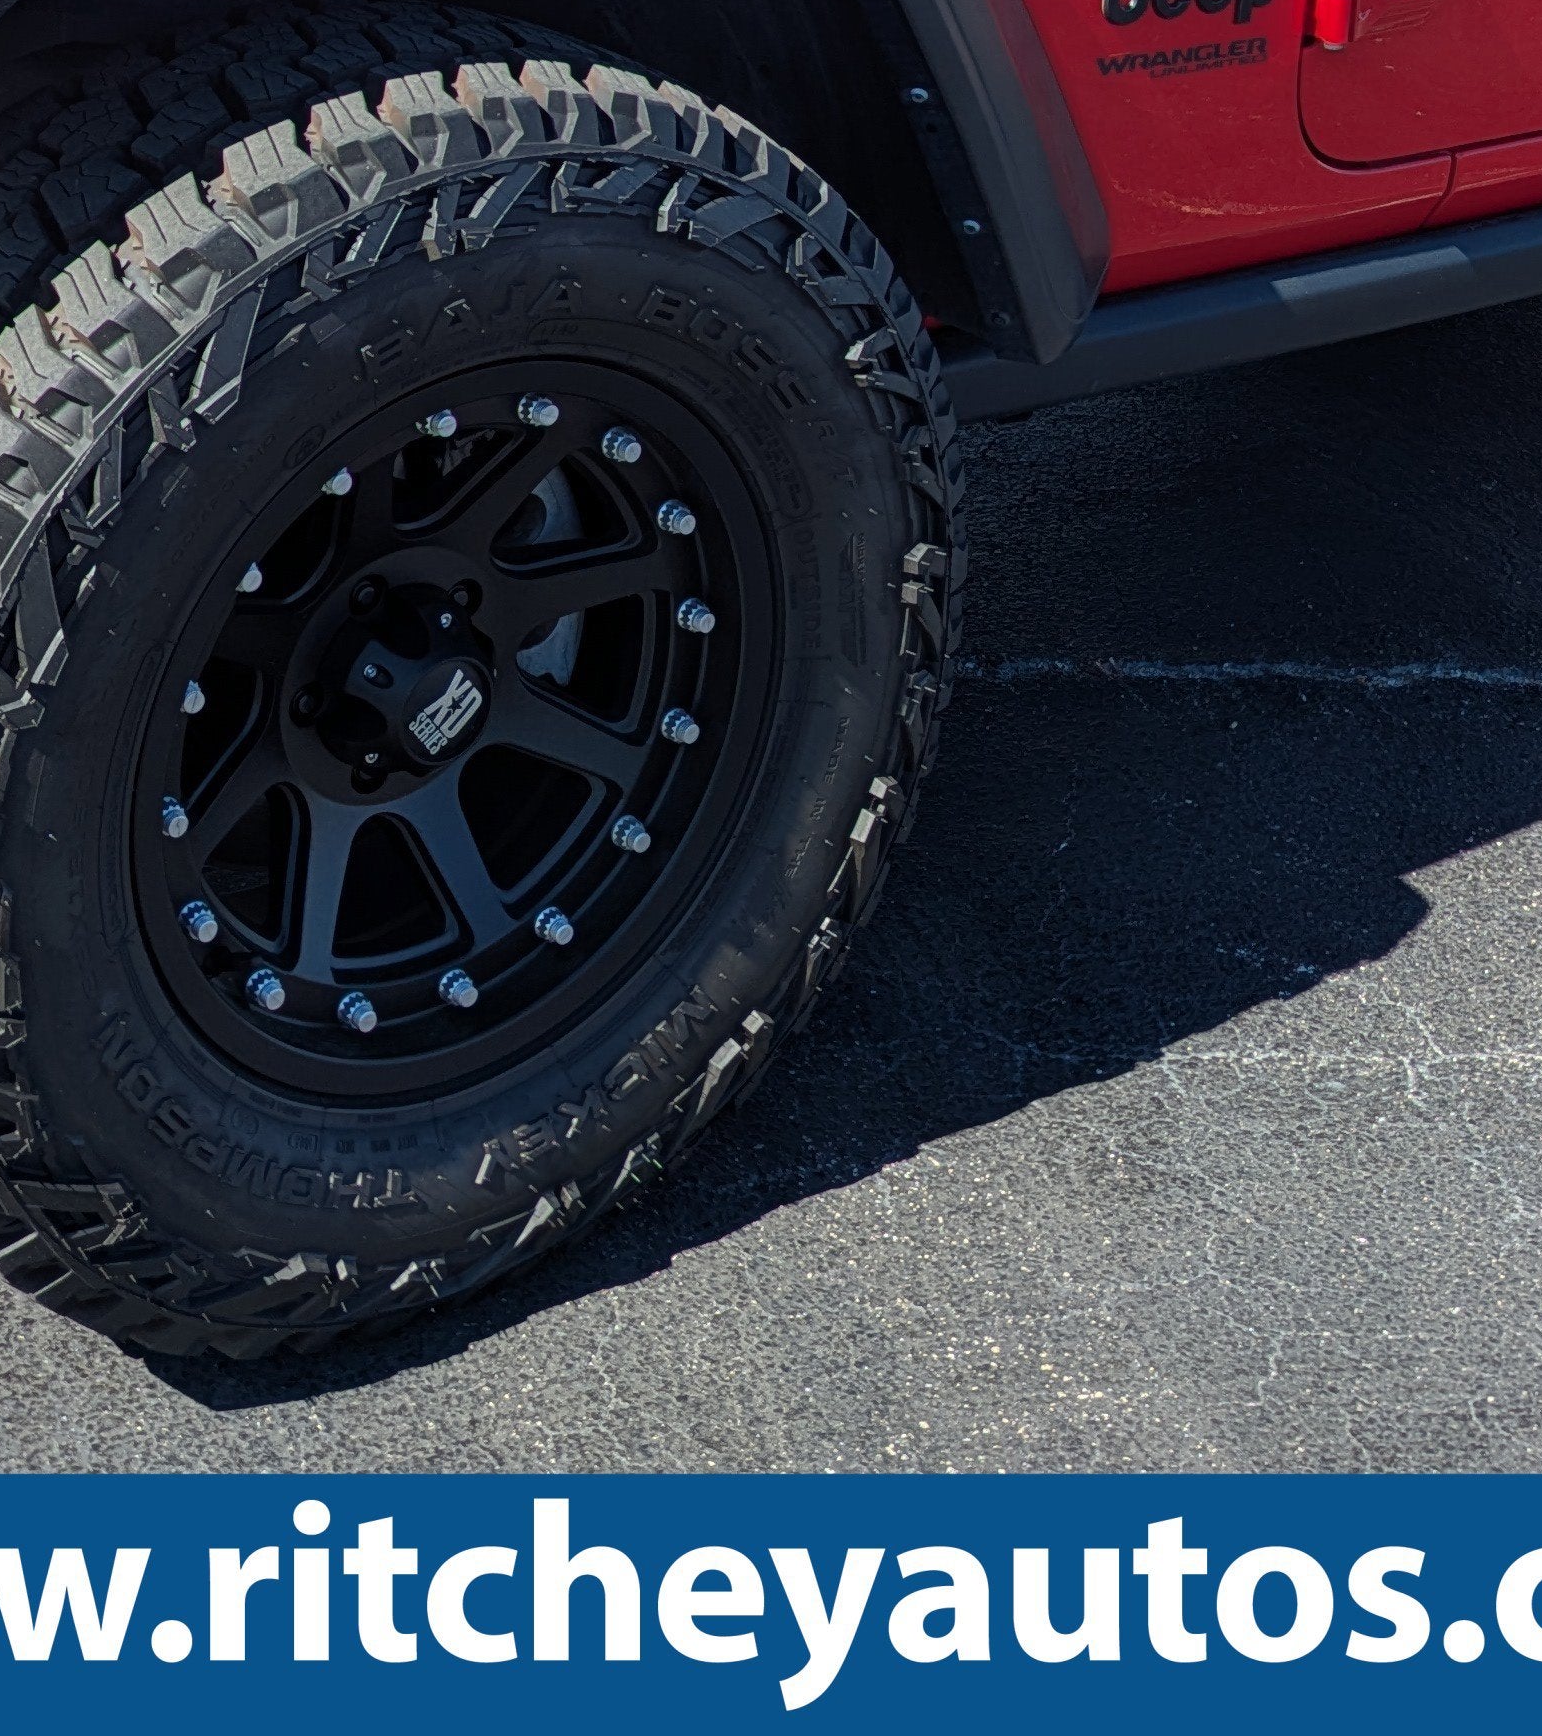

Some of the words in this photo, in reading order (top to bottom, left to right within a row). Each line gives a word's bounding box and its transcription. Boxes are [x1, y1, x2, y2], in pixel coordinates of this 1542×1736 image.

[1096, 38, 1267, 77] WRANGLER
[636, 281, 815, 424] BOSS
[423, 668, 483, 739] XD
[409, 711, 448, 755] SERIES
